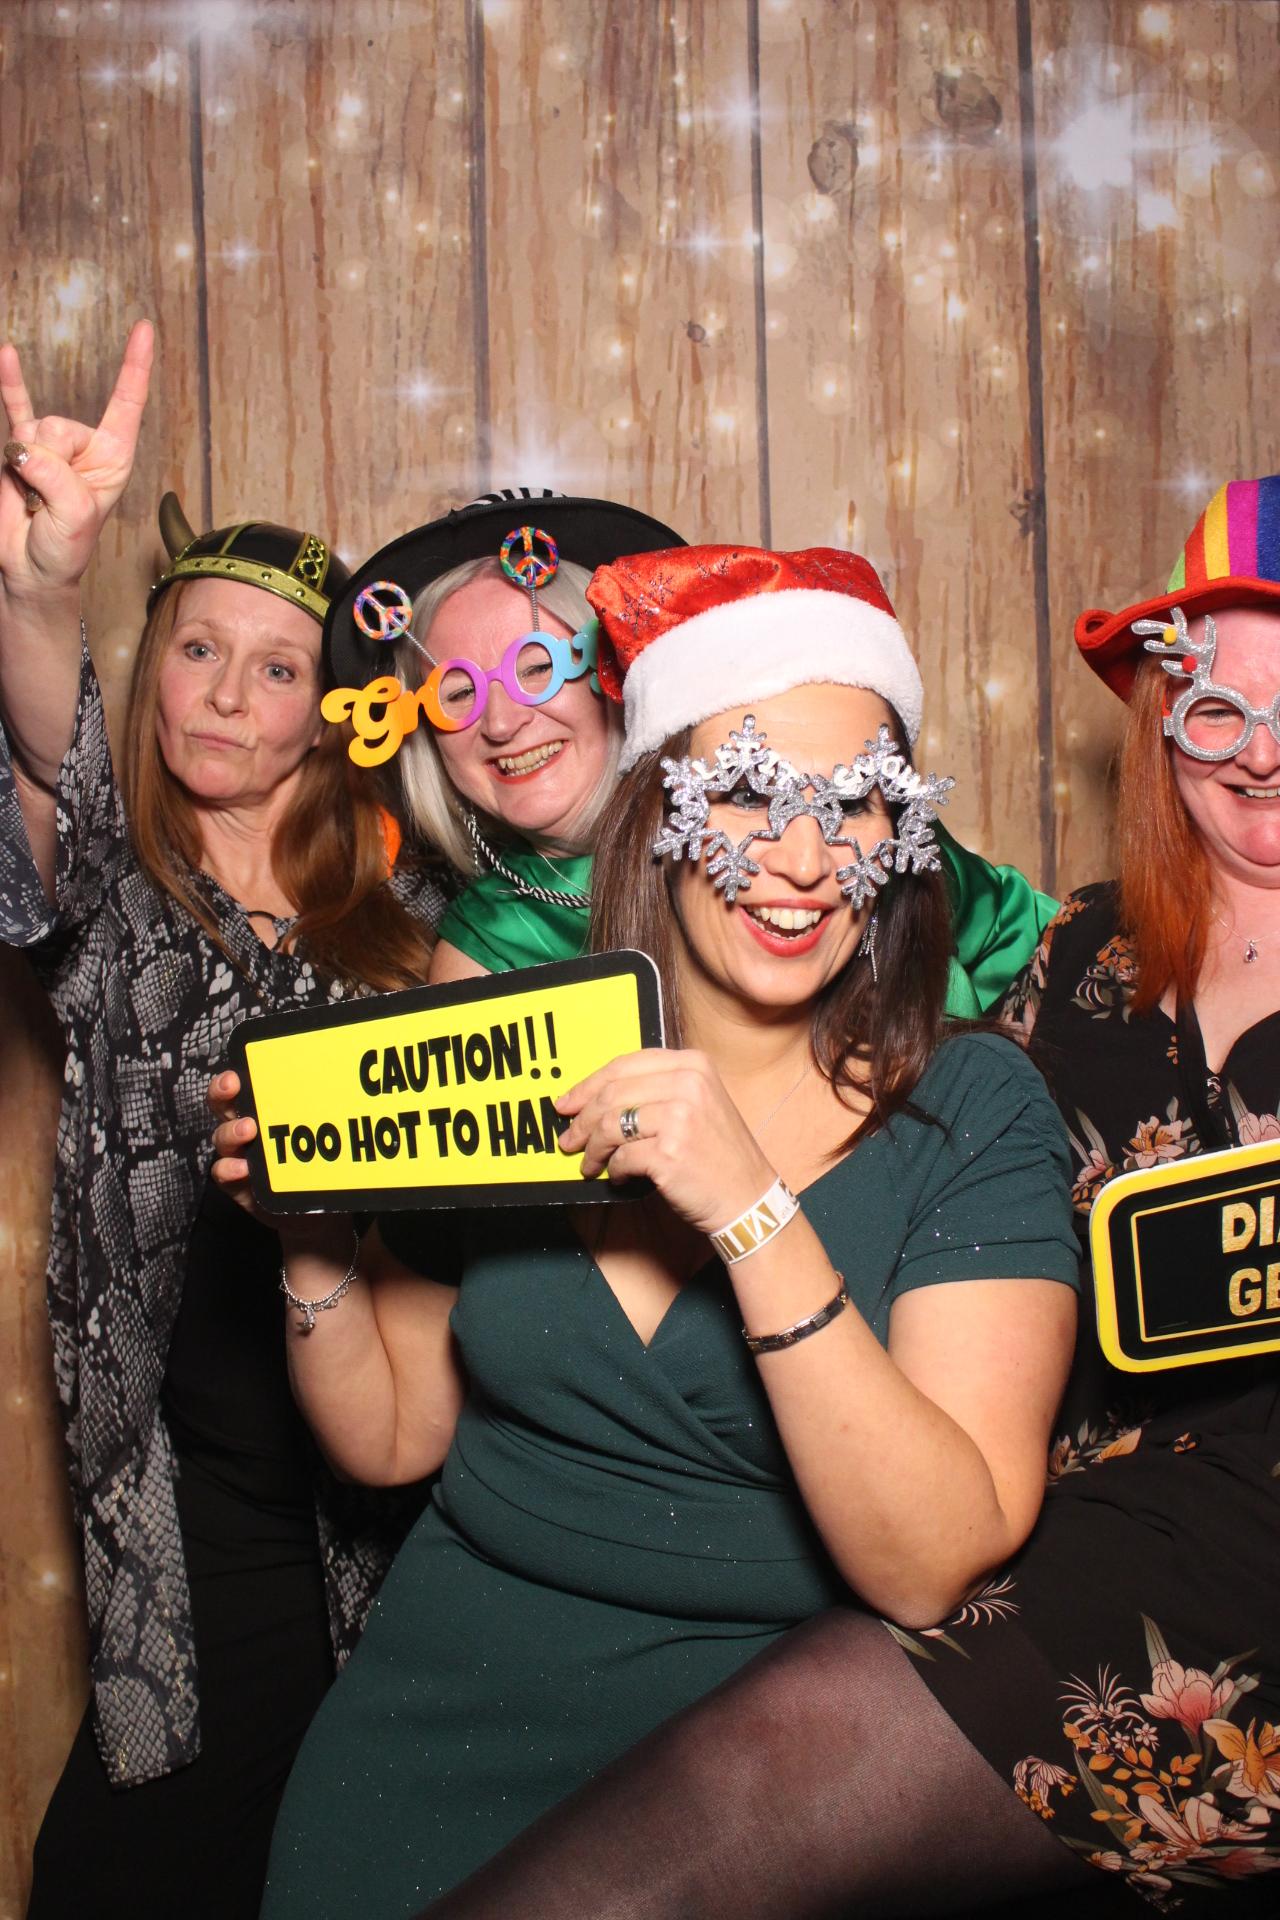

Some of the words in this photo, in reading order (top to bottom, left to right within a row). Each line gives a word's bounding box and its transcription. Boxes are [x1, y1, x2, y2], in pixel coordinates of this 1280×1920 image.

[691, 740, 762, 781] LET
[833, 755, 928, 795] SNOW
[360, 1011, 562, 1097] CAUTION!!
[269, 1122, 342, 1164] TOO
[349, 1110, 421, 1162] HOT
[429, 1107, 480, 1158] TO
[1222, 1195, 1280, 1254] DI
